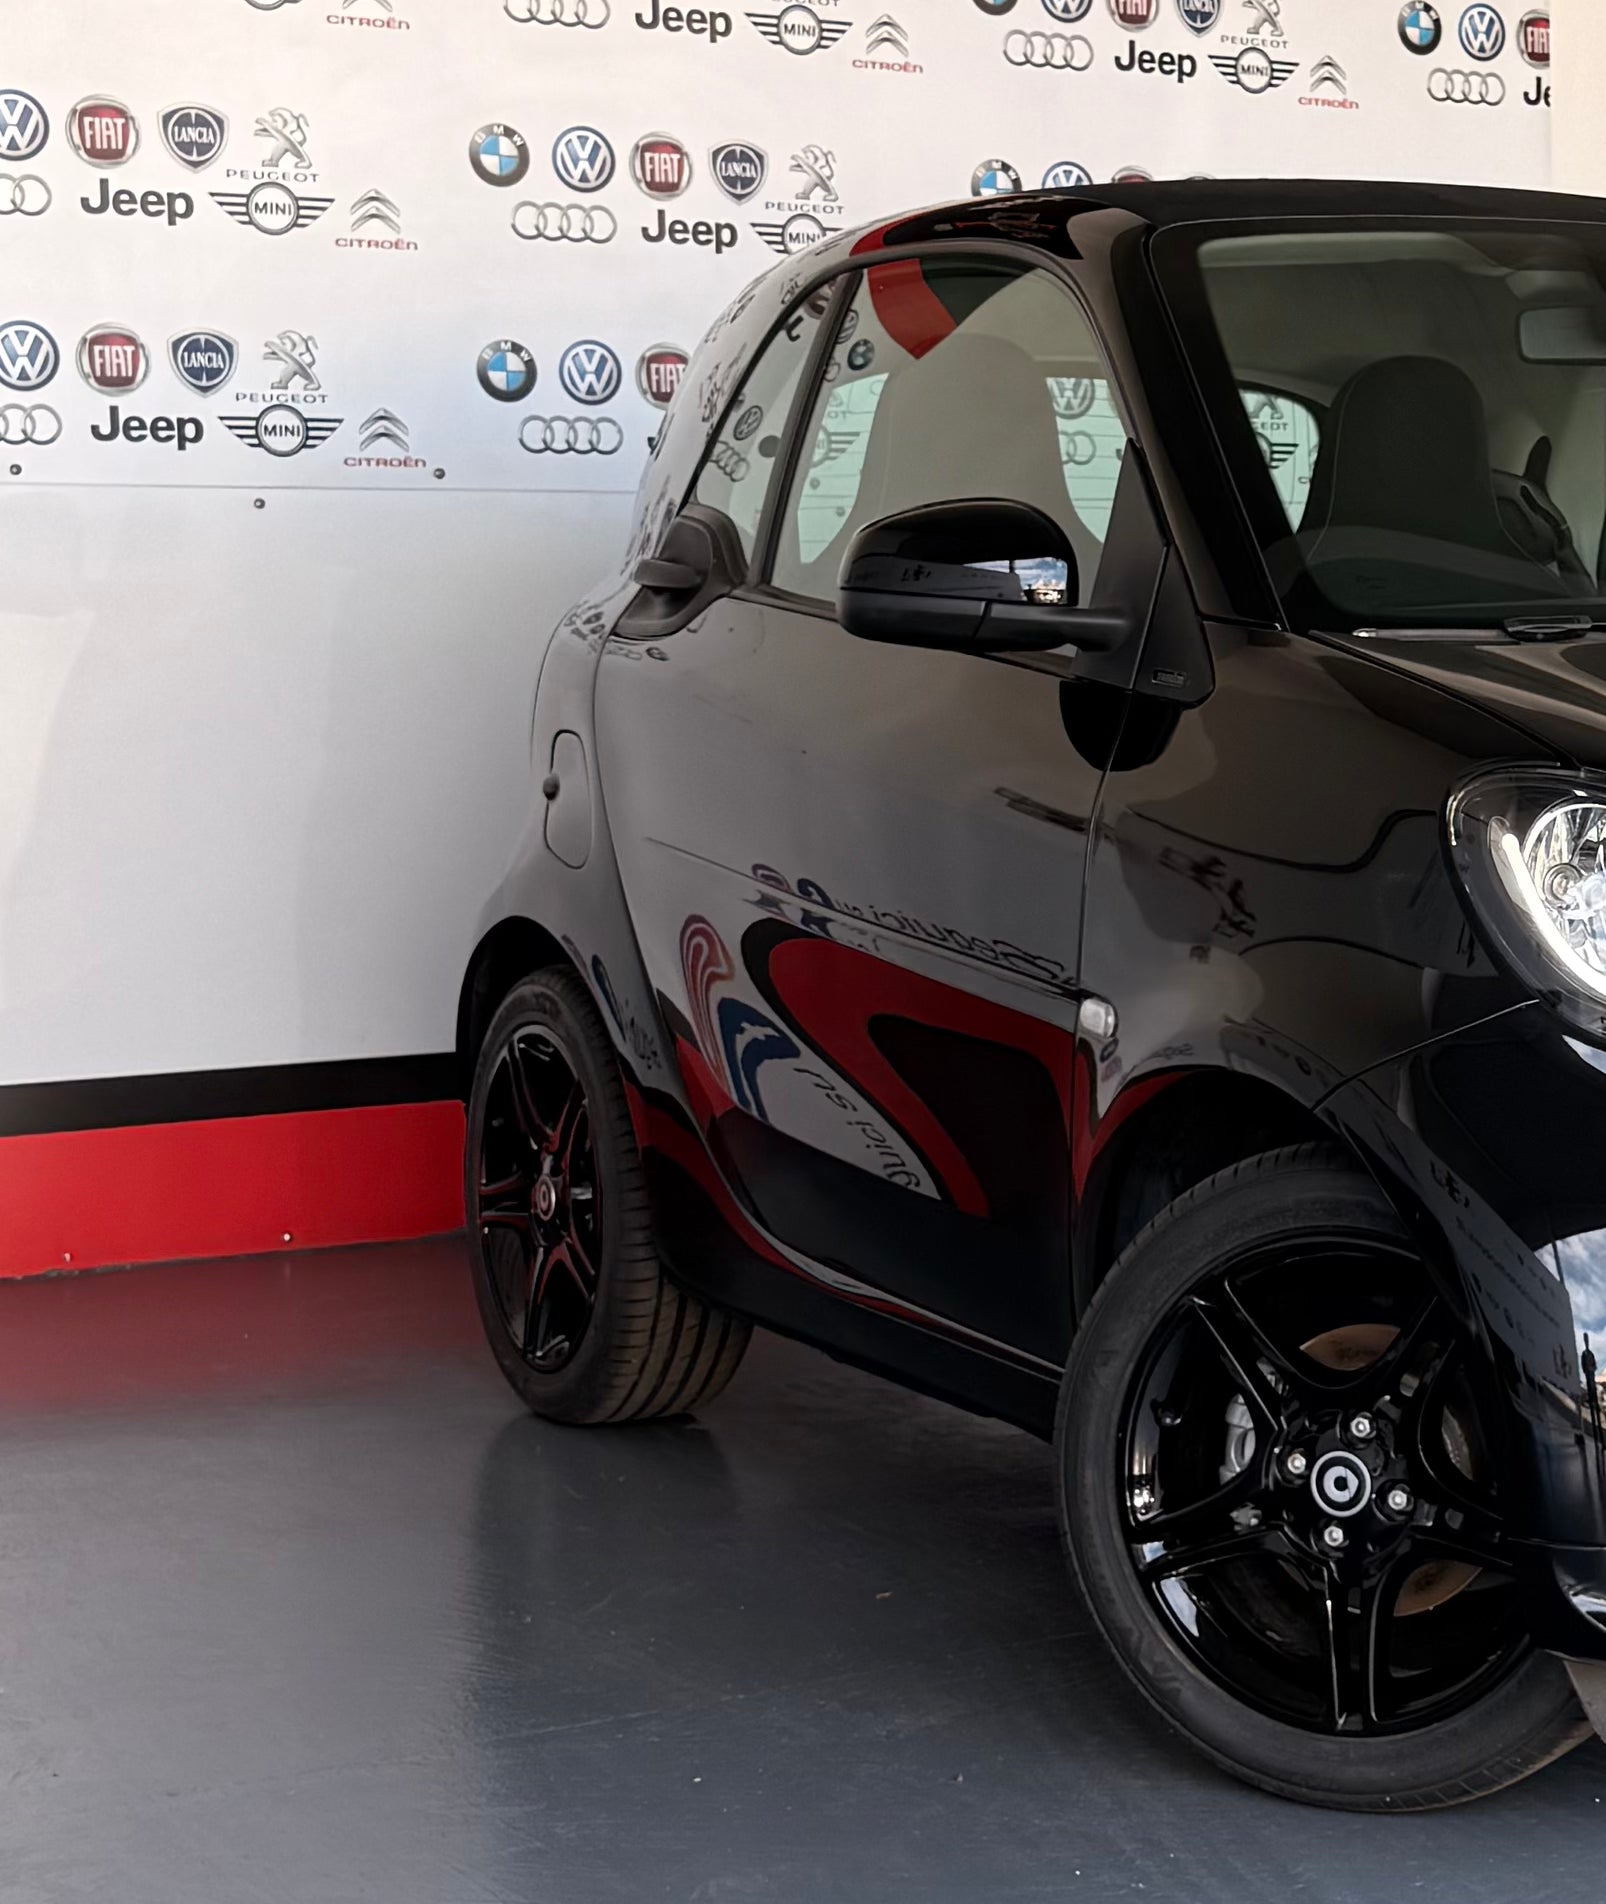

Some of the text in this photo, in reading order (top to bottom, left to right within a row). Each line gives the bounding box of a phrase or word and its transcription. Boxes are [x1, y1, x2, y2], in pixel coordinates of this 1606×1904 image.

[783, 23, 817, 38] MINI
[1220, 34, 1289, 50] PEUGEOT
[1114, 40, 1197, 83] Jeep
[1240, 64, 1269, 77] MINI
[83, 117, 126, 150] FIAT
[174, 125, 215, 144] LANCIA
[226, 169, 320, 183] PEUGEOT
[644, 152, 681, 184] FIAT
[80, 178, 194, 226] Jeep
[254, 201, 292, 216] MINI
[765, 201, 845, 215] PEUGEOT
[641, 208, 738, 254] Jeep
[93, 344, 136, 378] FIAT
[183, 351, 224, 369] LANCIA
[235, 392, 328, 405] PEUGEOT
[90, 405, 204, 451] Jeep
[263, 424, 300, 438] MINI
